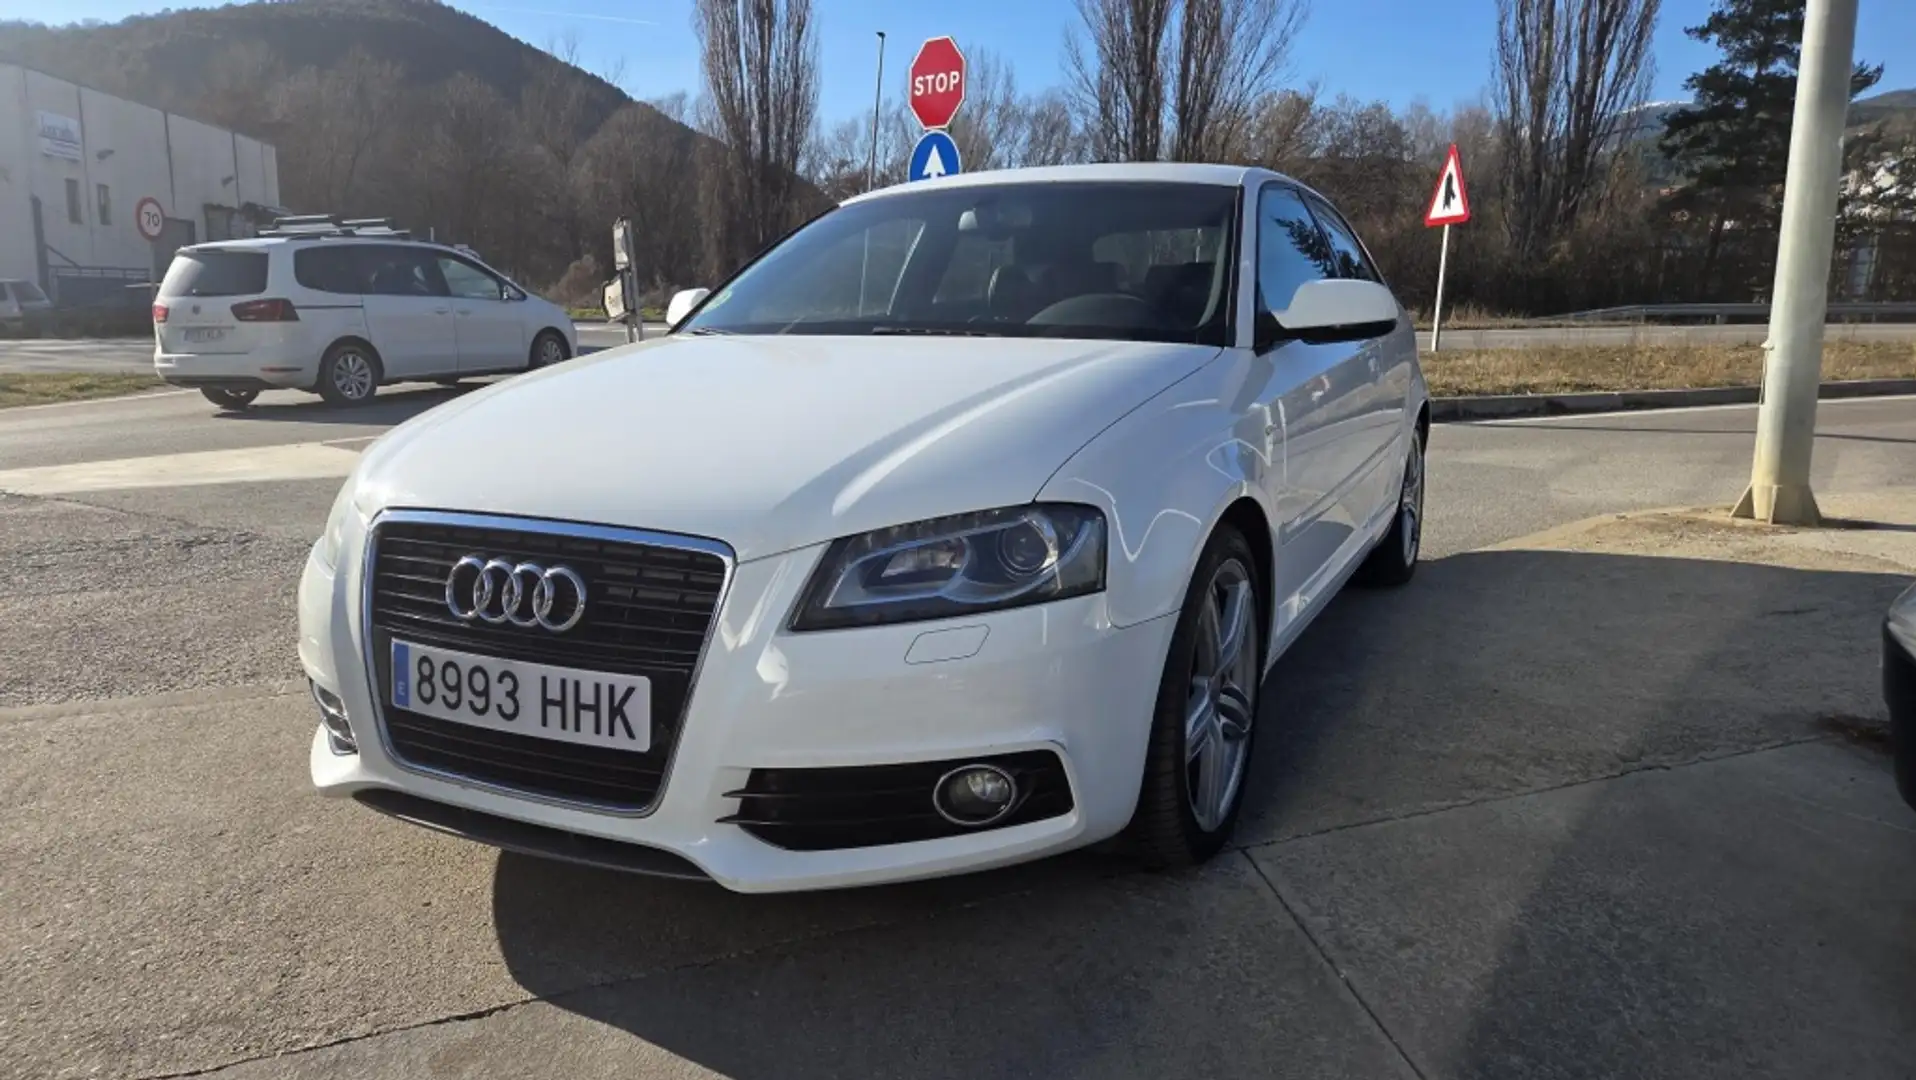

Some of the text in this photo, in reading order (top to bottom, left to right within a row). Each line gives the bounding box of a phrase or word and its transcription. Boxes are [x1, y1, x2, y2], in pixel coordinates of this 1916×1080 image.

[914, 71, 960, 96] STOP
[143, 211, 160, 227] 70
[397, 681, 405, 696] E
[417, 656, 637, 741] 8993 HHK
